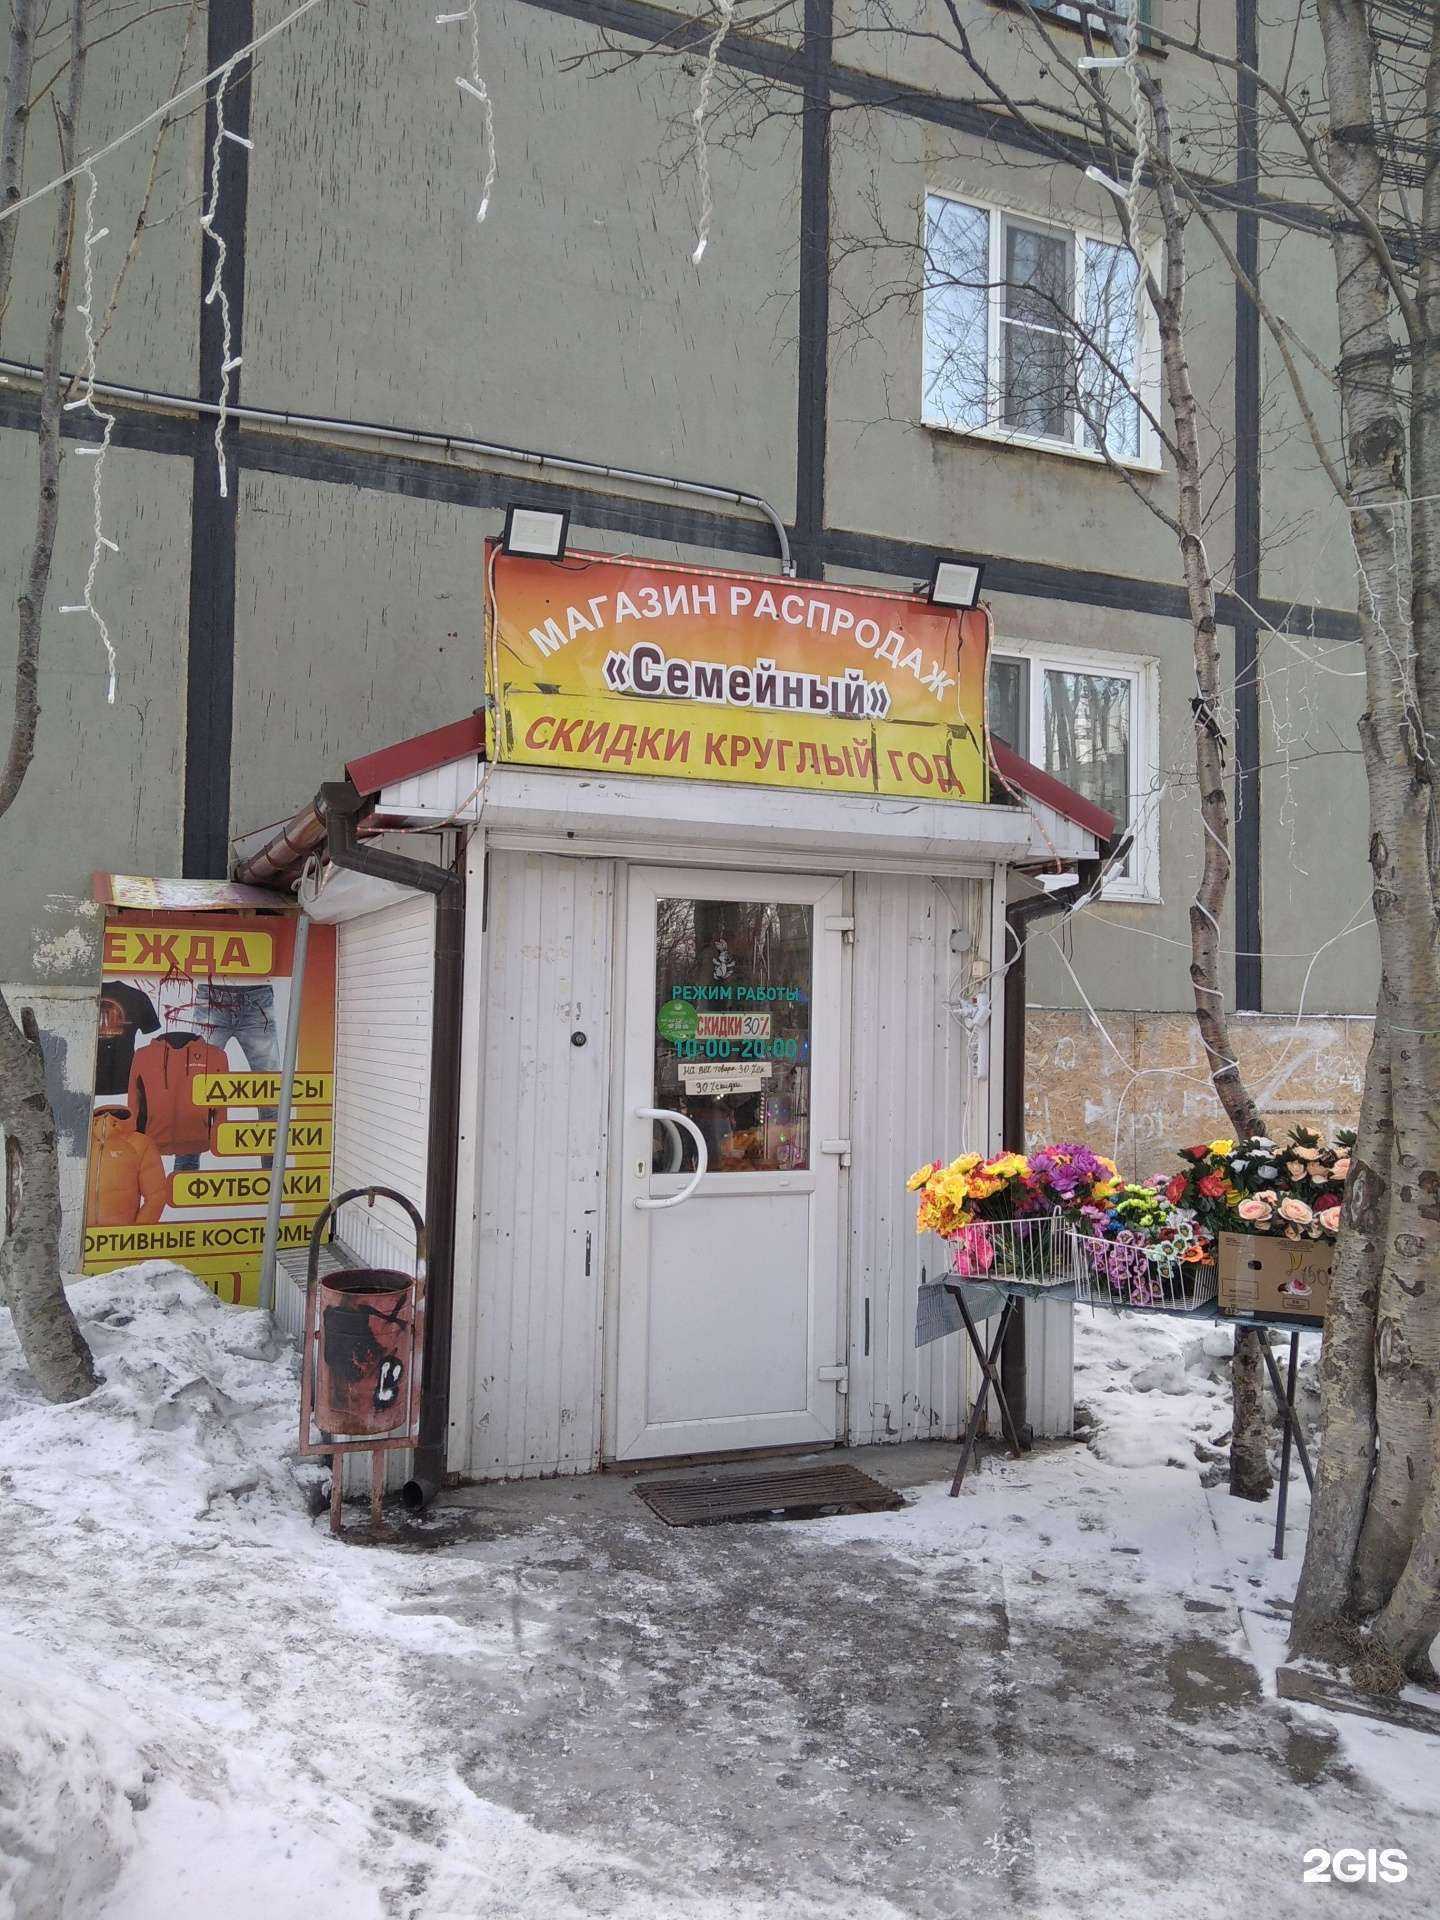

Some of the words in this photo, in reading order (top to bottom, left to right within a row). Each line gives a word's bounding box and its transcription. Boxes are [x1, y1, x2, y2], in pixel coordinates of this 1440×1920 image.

[528, 584, 717, 657] МАГАЗИН
[730, 586, 955, 701] РАСПРОДАЖ
[602, 641, 892, 718] «Семейный»
[525, 716, 690, 765] СКИДКИ
[705, 733, 874, 779] КРУГЛЫЙ
[887, 749, 966, 795] ГОД
[672, 985, 732, 1000] РЕЖИМ
[736, 986, 801, 1001] РАБОТЫ
[697, 1015, 742, 1037] СКИДКИ
[235, 1128, 322, 1148] КУРКИ
